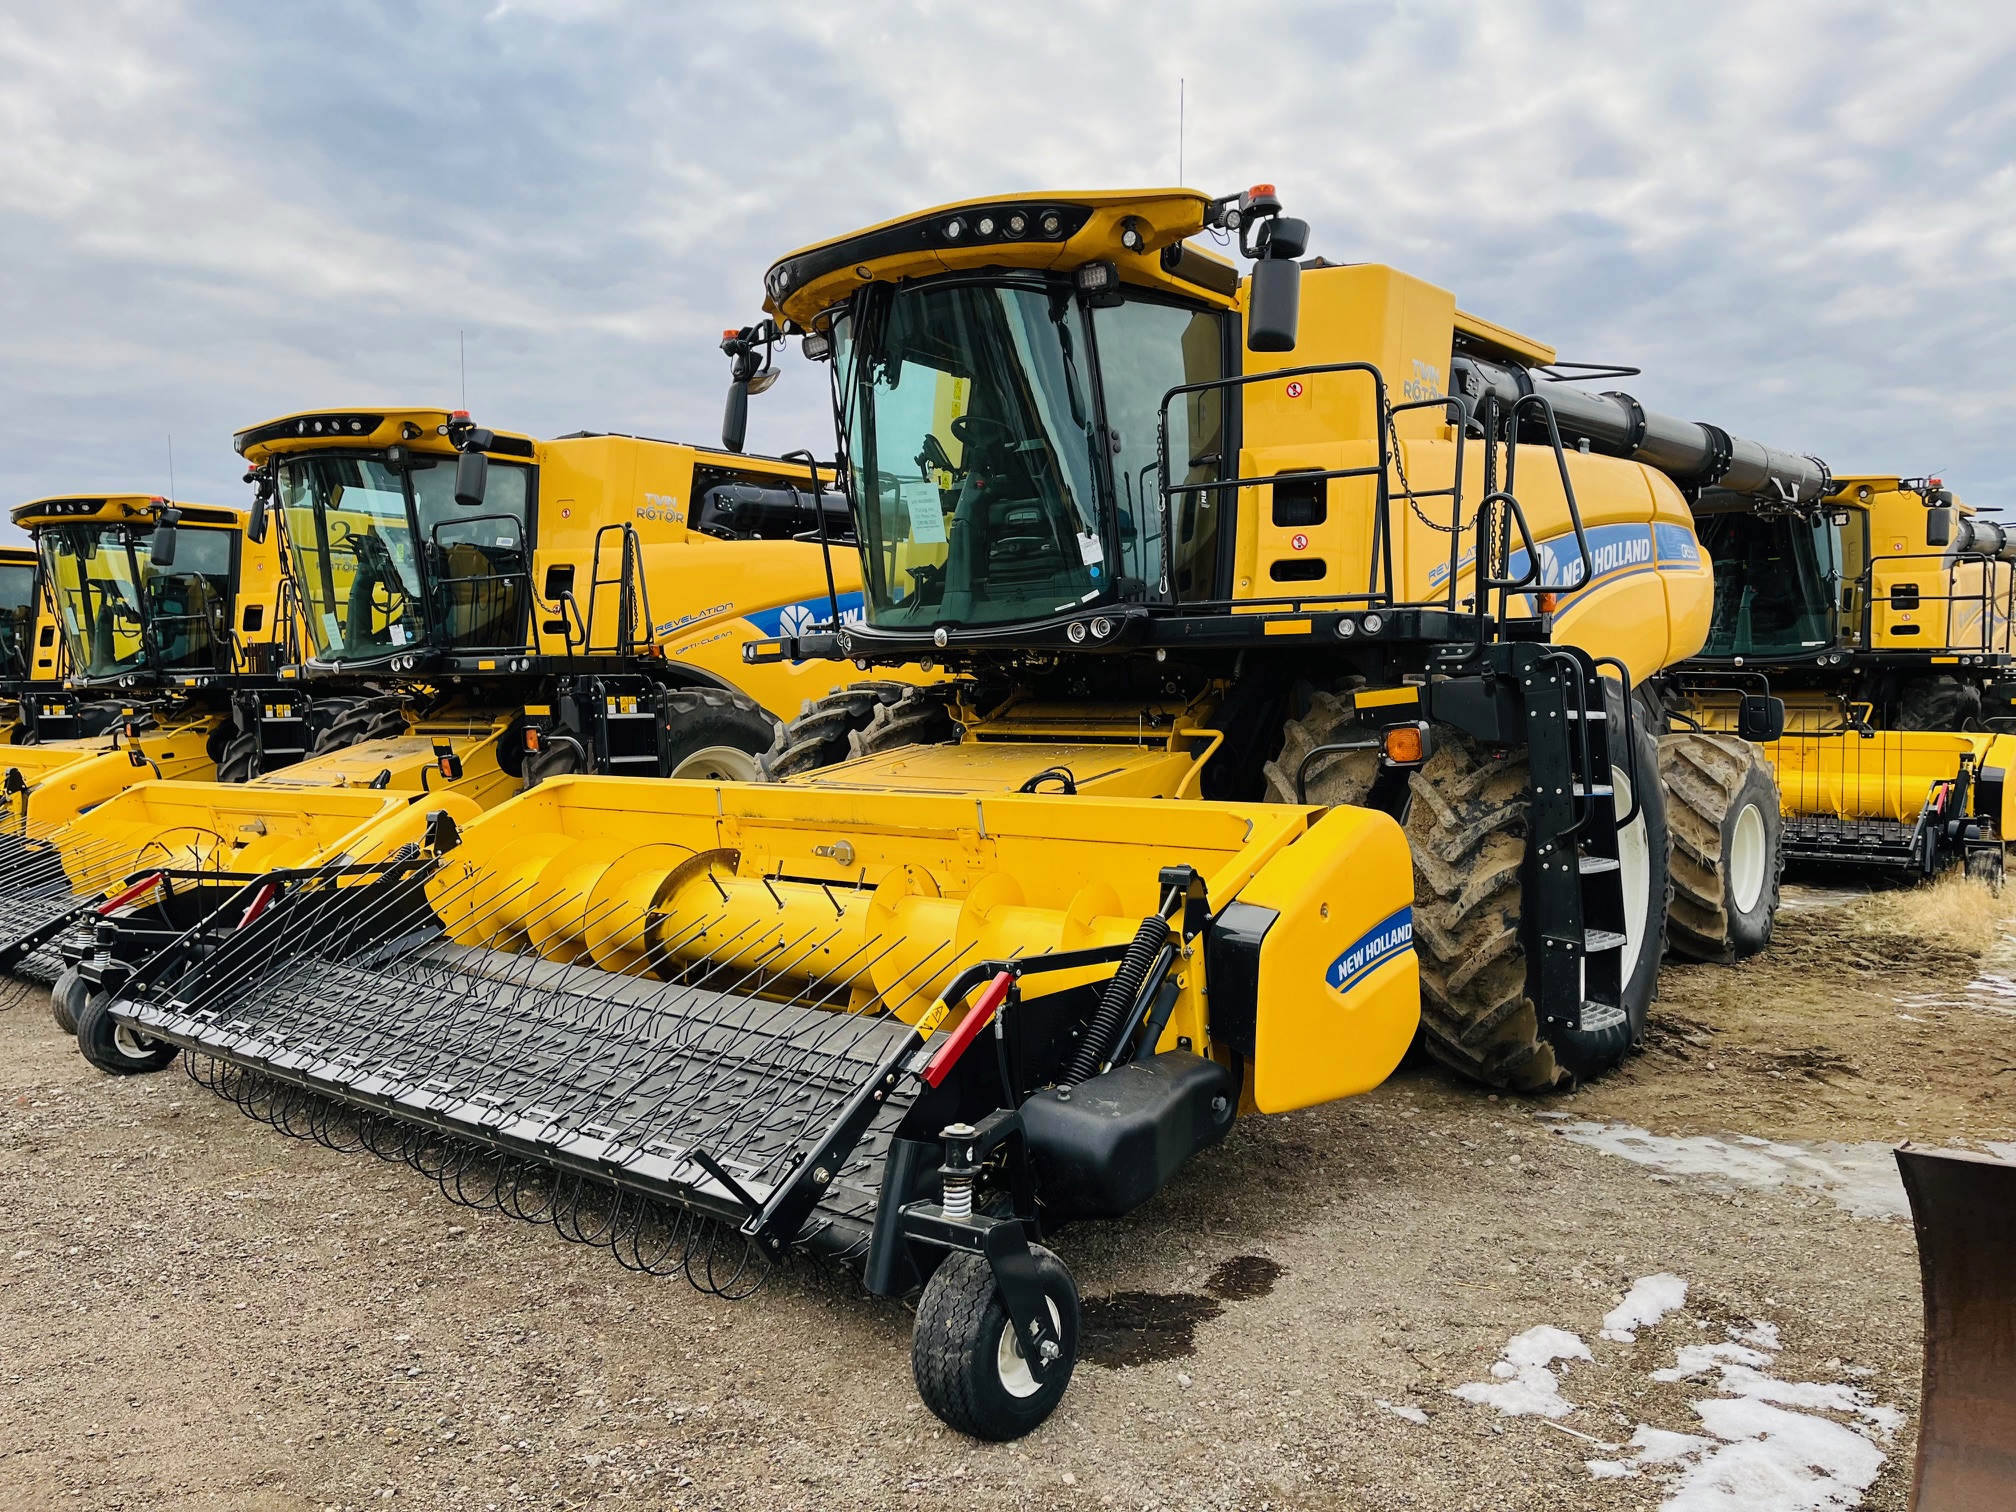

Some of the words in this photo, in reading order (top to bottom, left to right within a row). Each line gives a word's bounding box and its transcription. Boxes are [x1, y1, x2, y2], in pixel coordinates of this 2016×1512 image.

[636, 504, 684, 524] ROTOR
[644, 492, 678, 508] TWIN
[330, 521, 355, 549] 2
[1594, 538, 1651, 575] HOLLAND
[655, 602, 734, 633] REVELATION
[675, 630, 733, 655] OPTI-CLEAN
[1338, 947, 1364, 981] NEW
[1365, 922, 1413, 961] HOLLAND
